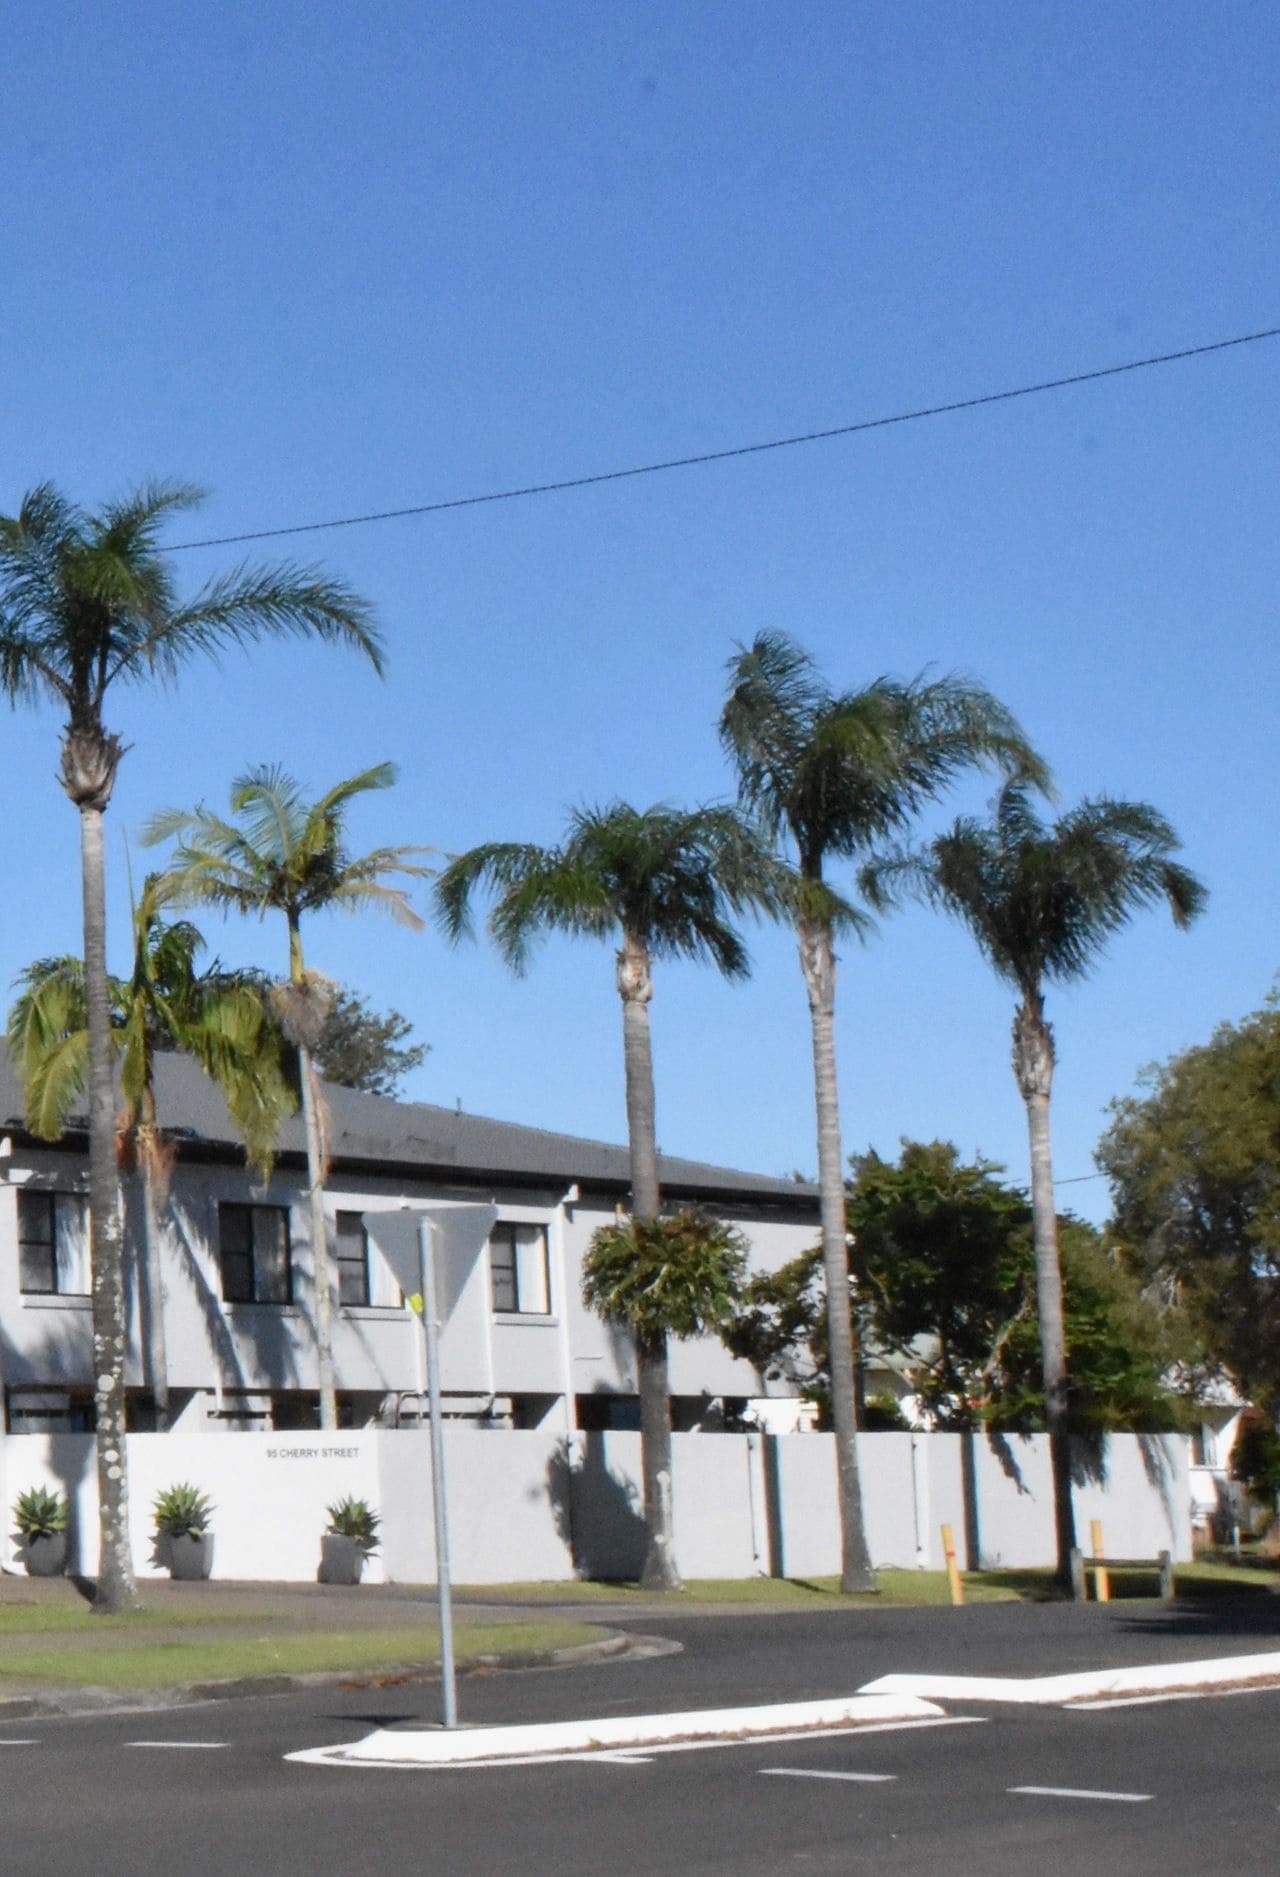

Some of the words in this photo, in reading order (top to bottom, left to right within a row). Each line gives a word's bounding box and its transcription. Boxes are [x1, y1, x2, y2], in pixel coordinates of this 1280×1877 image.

[266, 1448, 278, 1458] 95
[279, 1448, 319, 1458] CHERRY
[321, 1447, 359, 1458] STREET
